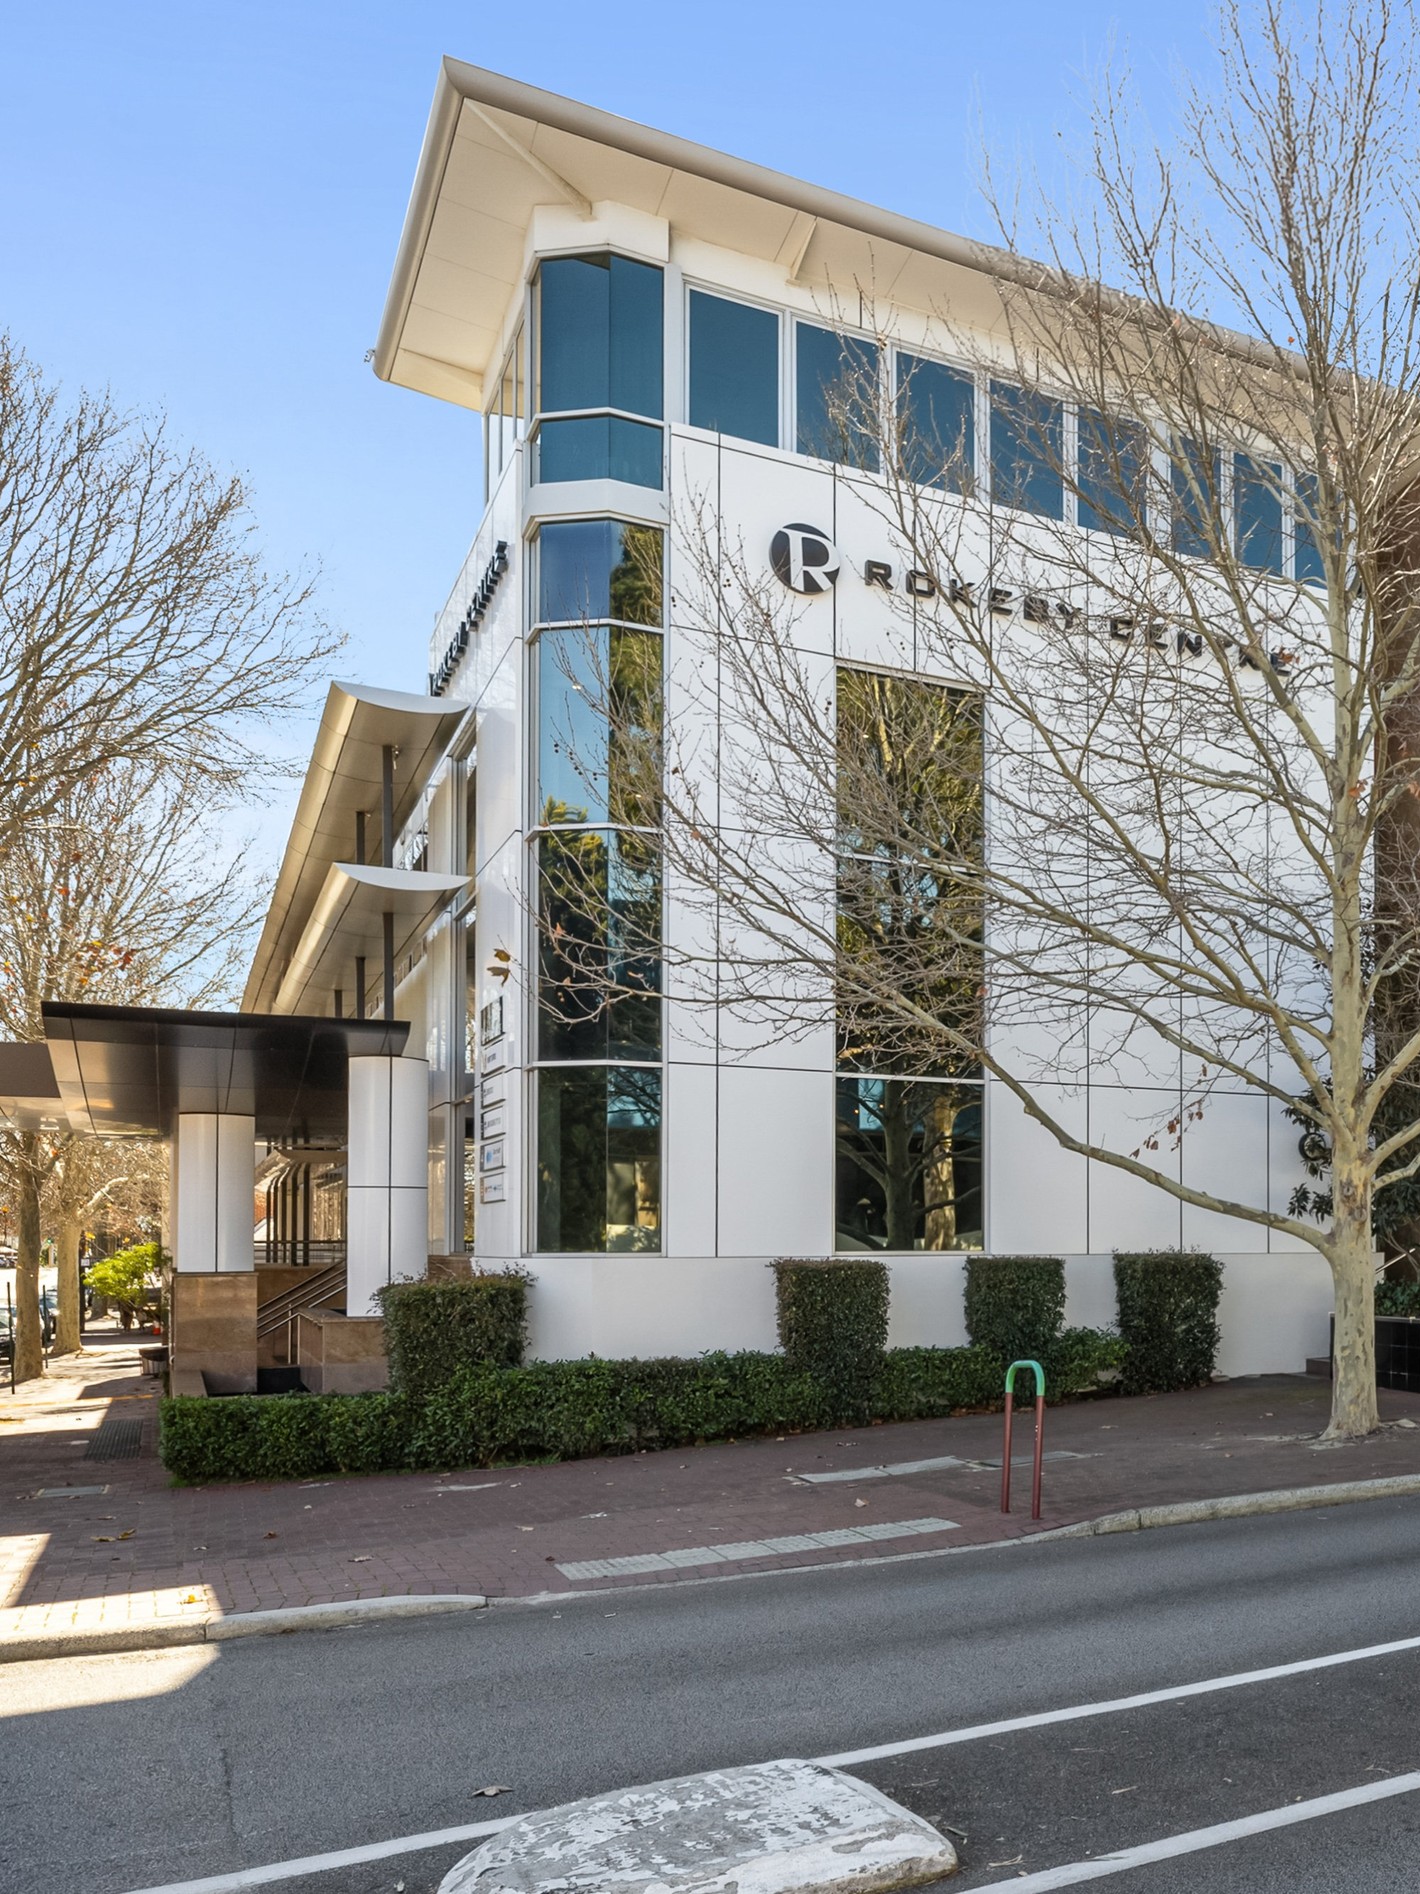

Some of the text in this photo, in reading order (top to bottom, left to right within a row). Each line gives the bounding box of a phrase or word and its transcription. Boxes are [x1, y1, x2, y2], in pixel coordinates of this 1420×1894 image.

[774, 525, 1293, 678] R ROKEBY CENRE
